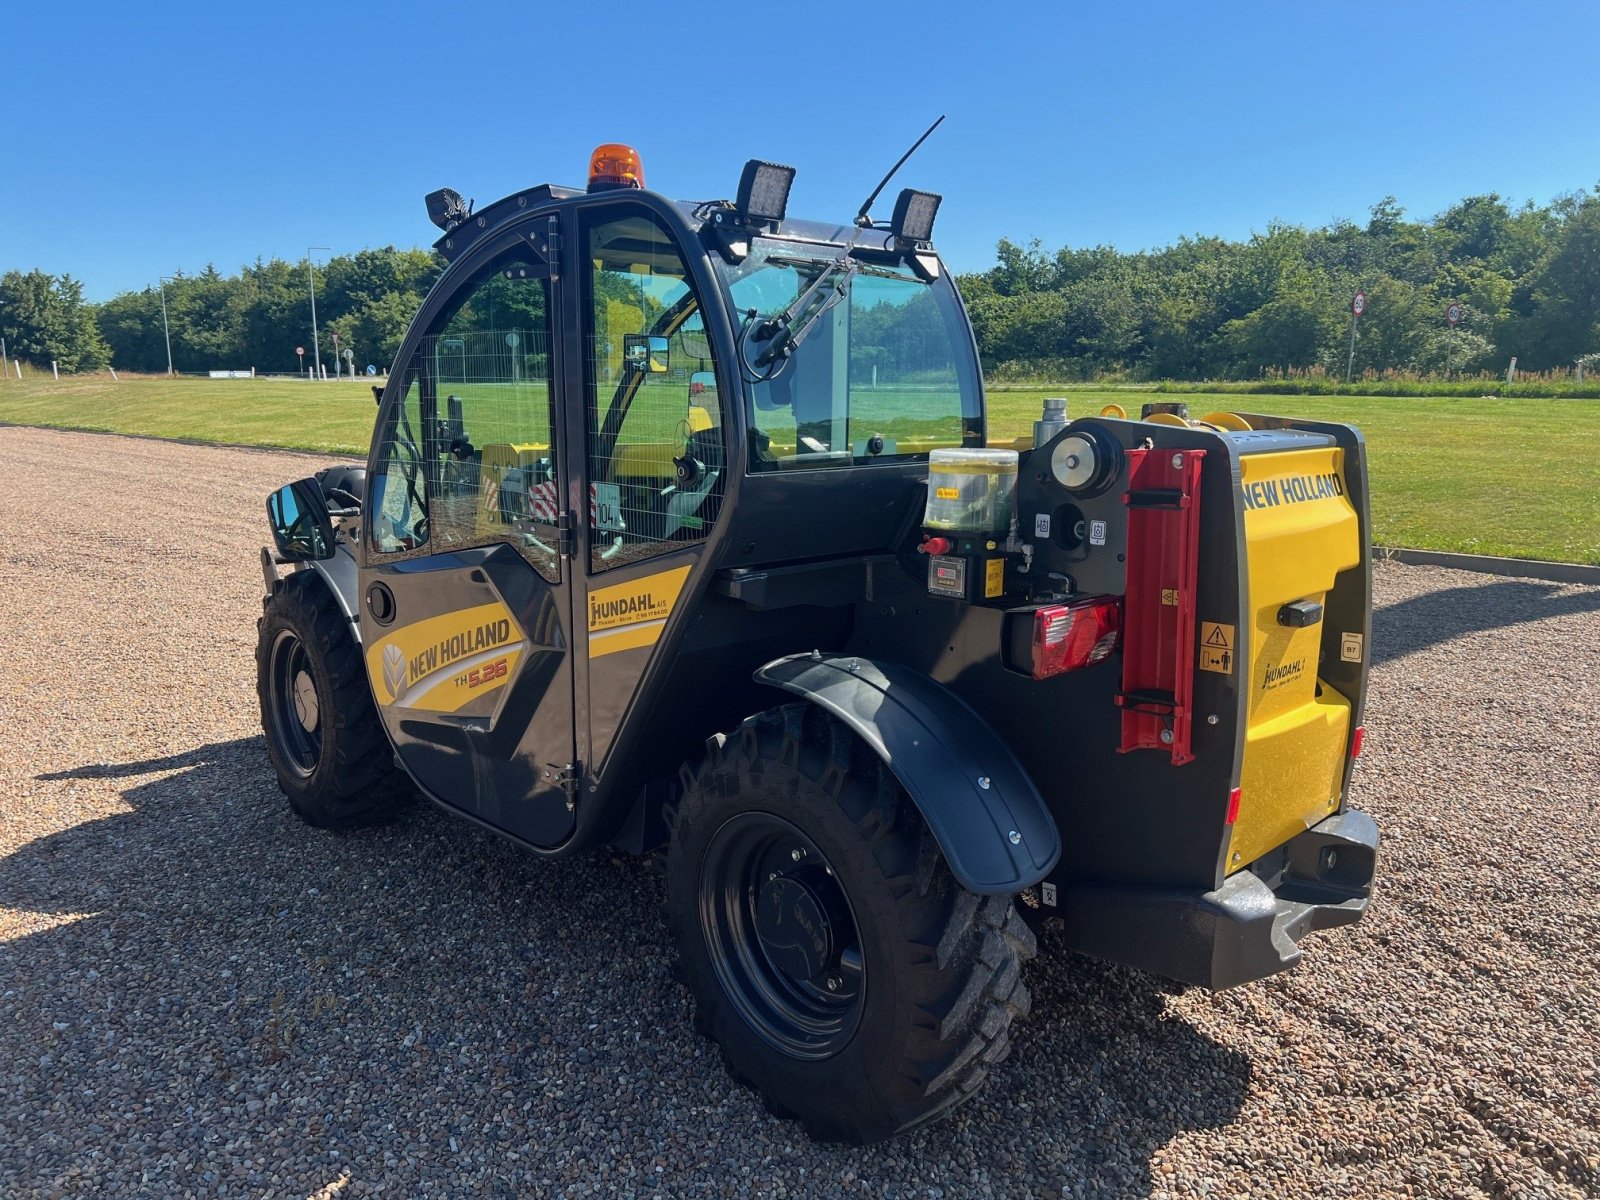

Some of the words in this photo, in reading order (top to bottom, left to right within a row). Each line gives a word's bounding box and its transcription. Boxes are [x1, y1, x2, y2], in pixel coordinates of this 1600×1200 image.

[1243, 480, 1280, 511] NEW
[1280, 472, 1343, 504] HOLLAND
[409, 644, 437, 682] NEW
[440, 618, 510, 665] HOLLAND
